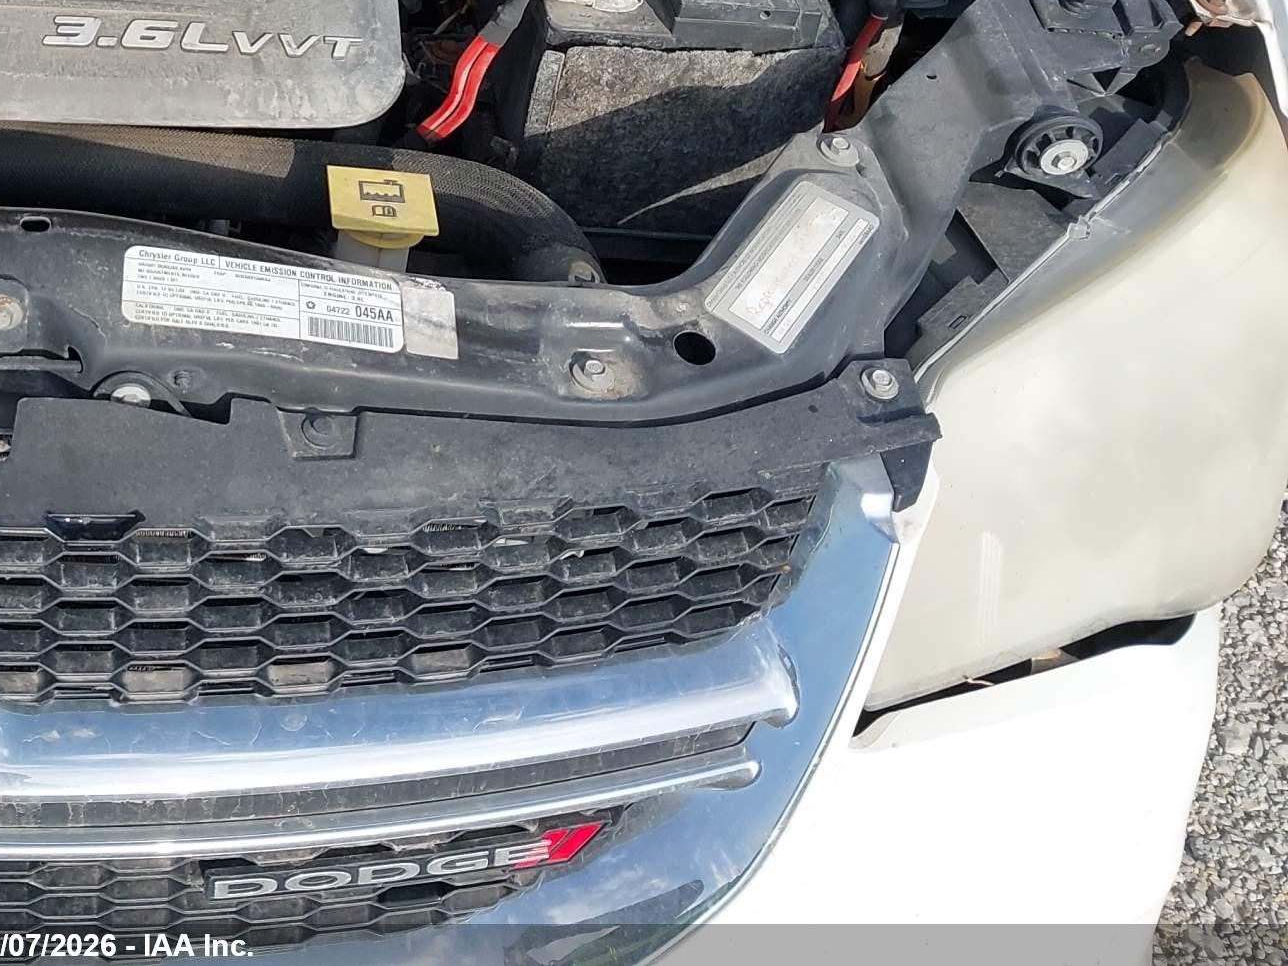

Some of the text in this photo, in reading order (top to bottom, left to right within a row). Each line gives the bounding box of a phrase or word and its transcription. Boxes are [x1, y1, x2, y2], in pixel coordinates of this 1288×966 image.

[232, 30, 363, 60] VVT
[138, 249, 216, 266] Chrysler Group LLC
[225, 260, 256, 271] VEHICLE
[260, 265, 297, 277] EMISSION
[300, 270, 335, 282] CONTROL
[338, 276, 392, 291] INFORMATION
[326, 305, 393, 322] 04722 045AA
[214, 838, 553, 900] DODGE
